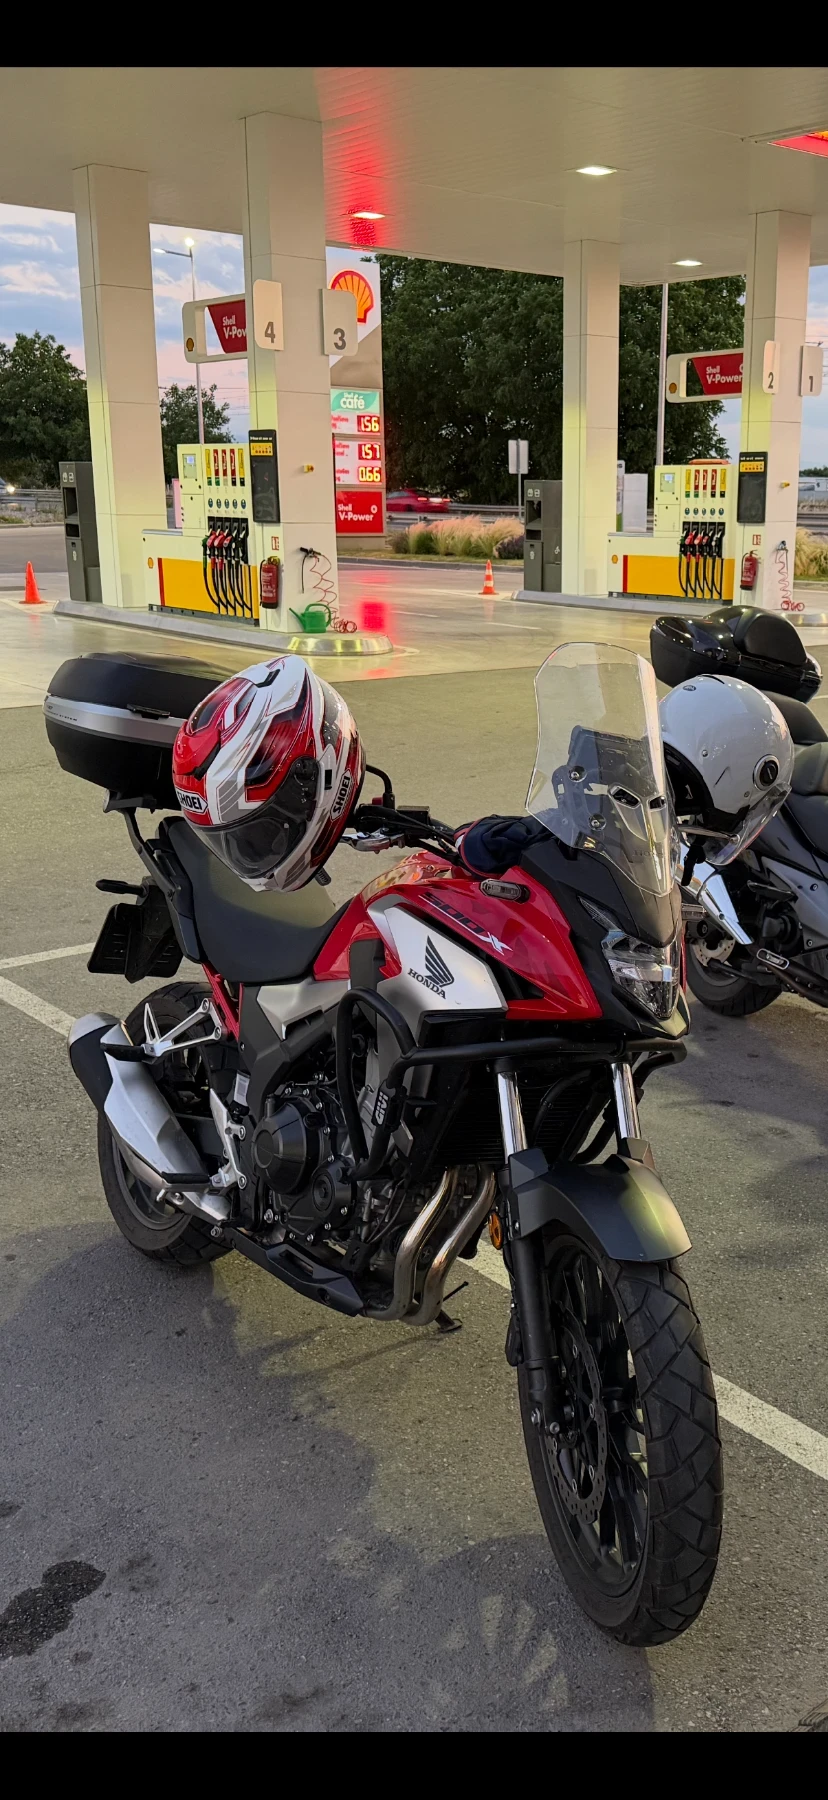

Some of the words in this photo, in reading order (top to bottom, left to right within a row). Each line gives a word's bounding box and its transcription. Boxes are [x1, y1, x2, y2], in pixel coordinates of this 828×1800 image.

[223, 314, 236, 326] Shell
[264, 321, 276, 344] 4
[333, 327, 347, 351] 3
[706, 365, 720, 374] Shell
[706, 373, 743, 384] V-Power
[767, 371, 774, 389] 2
[808, 375, 814, 393] 1
[340, 393, 365, 410] café
[337, 503, 353, 512] Shell
[339, 511, 374, 521] V-Power
[176, 790, 203, 811] SHOEI
[333, 775, 351, 814] SHOEI
[407, 967, 447, 1000] HONDA
[375, 1091, 389, 1125] GIVI
